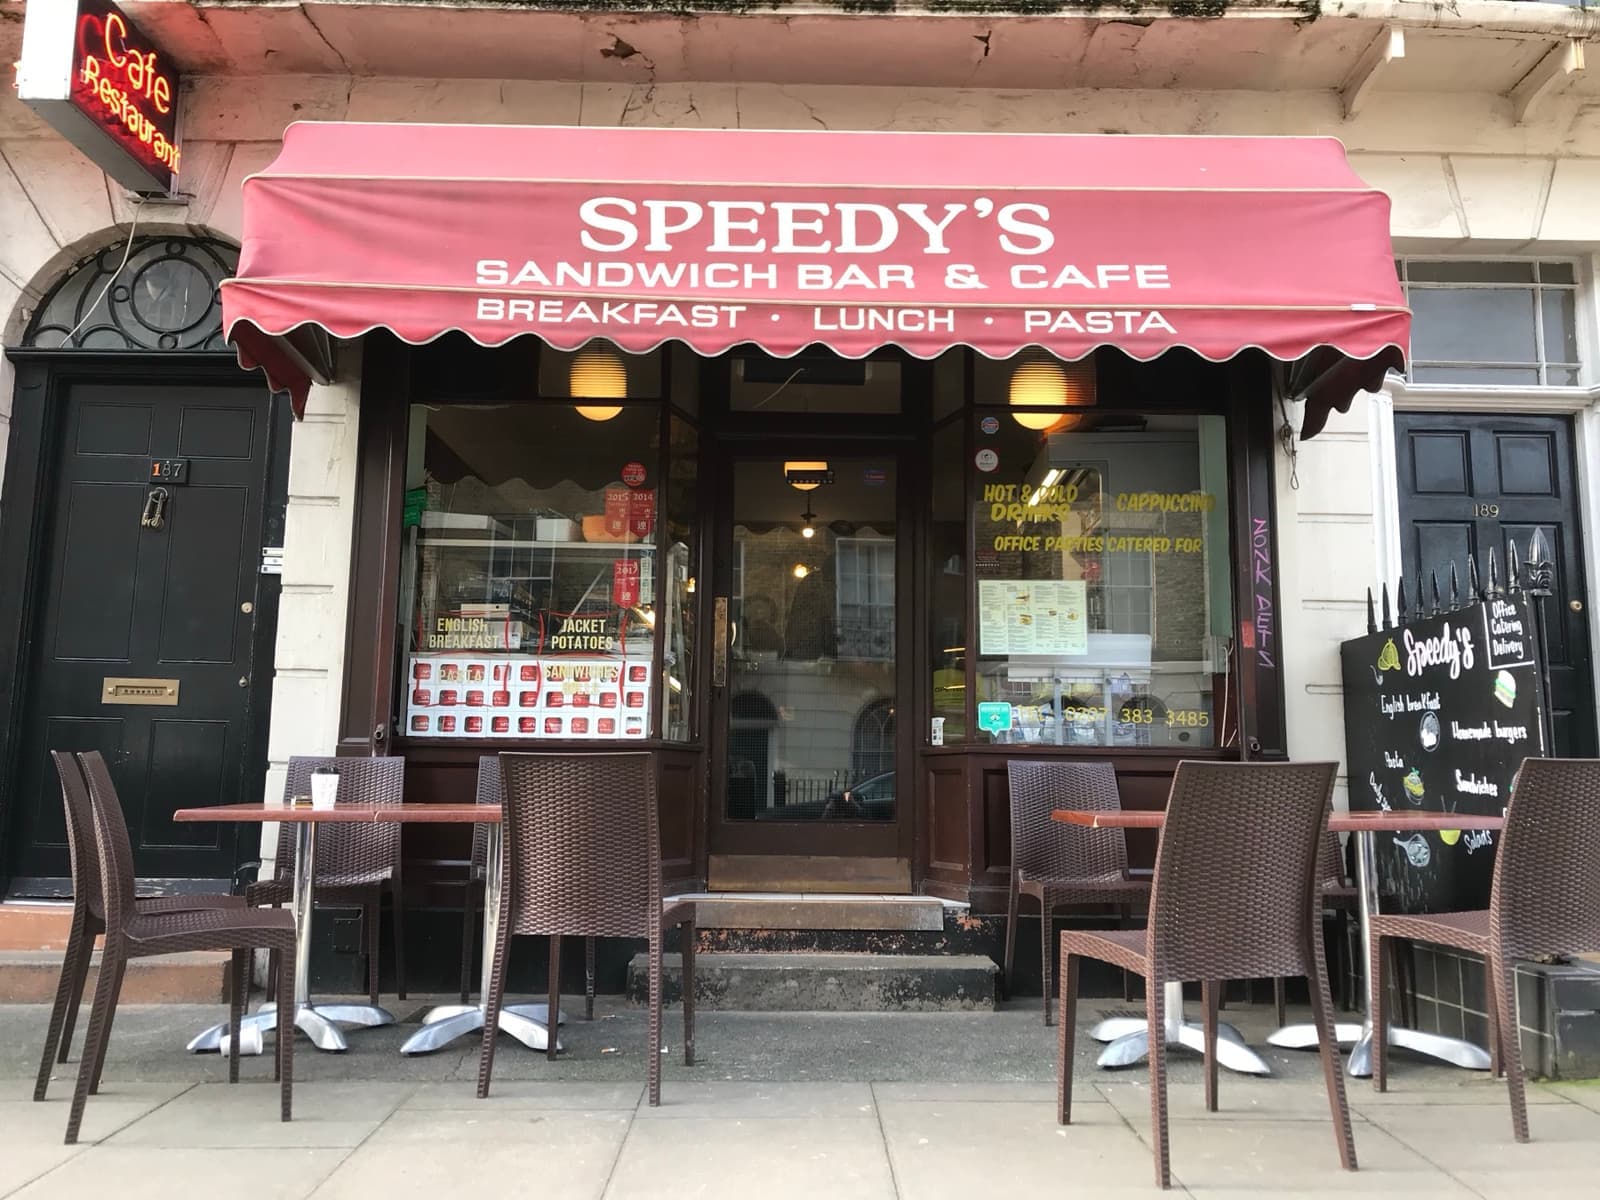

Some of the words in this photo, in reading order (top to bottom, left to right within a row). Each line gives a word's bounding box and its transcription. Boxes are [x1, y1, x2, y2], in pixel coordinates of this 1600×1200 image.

[105, 14, 170, 114] Cafe
[81, 55, 181, 175] Restaurant
[579, 196, 1055, 256] SPEEDY'S
[476, 259, 778, 290] SANDWICH
[798, 263, 916, 290] BAR
[944, 263, 989, 290] &
[1010, 263, 1171, 290] CAFE
[476, 298, 747, 329] BREAKFAST
[813, 306, 955, 333] LUNCH
[1024, 310, 1178, 335] PASTA
[152, 462, 182, 477] 187
[984, 483, 1017, 502] HOT
[1474, 503, 1499, 518] 189
[994, 536, 1041, 552] OFFICE
[1044, 536, 1103, 552] PARTIES
[1106, 536, 1172, 553] CATERED
[1174, 537, 1203, 553] FOR
[1492, 599, 1517, 618] Office
[437, 617, 491, 632] ENGLISH
[560, 618, 607, 634] JACKET
[1491, 618, 1523, 636] Catering
[429, 634, 499, 649] BREAKFAST
[551, 635, 613, 650] POTATOES
[1492, 637, 1524, 660] Delivery
[1121, 708, 1154, 725] 383
[1165, 709, 1209, 728] 3485
[1494, 719, 1528, 745] burgers
[1455, 768, 1499, 797] Sandwiches
